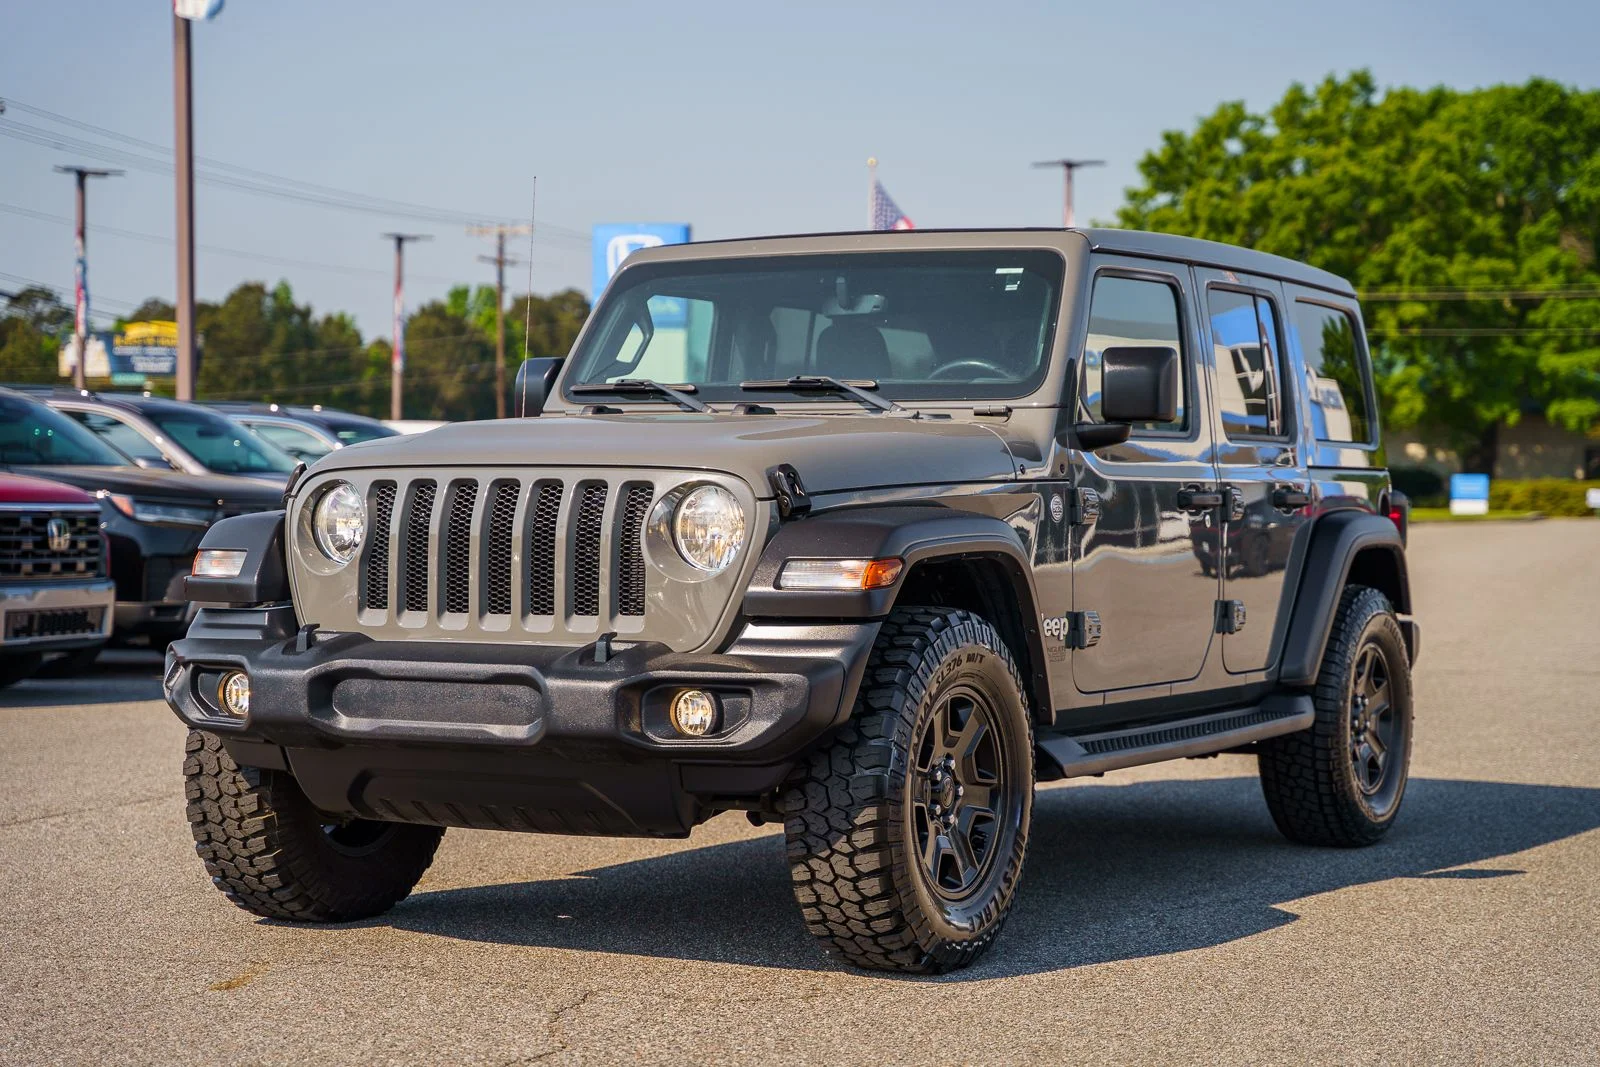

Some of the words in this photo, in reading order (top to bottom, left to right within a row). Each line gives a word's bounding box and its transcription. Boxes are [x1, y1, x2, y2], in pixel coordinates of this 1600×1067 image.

[1041, 612, 1069, 641] eep
[935, 654, 963, 686] SL376
[966, 652, 986, 664] M/T
